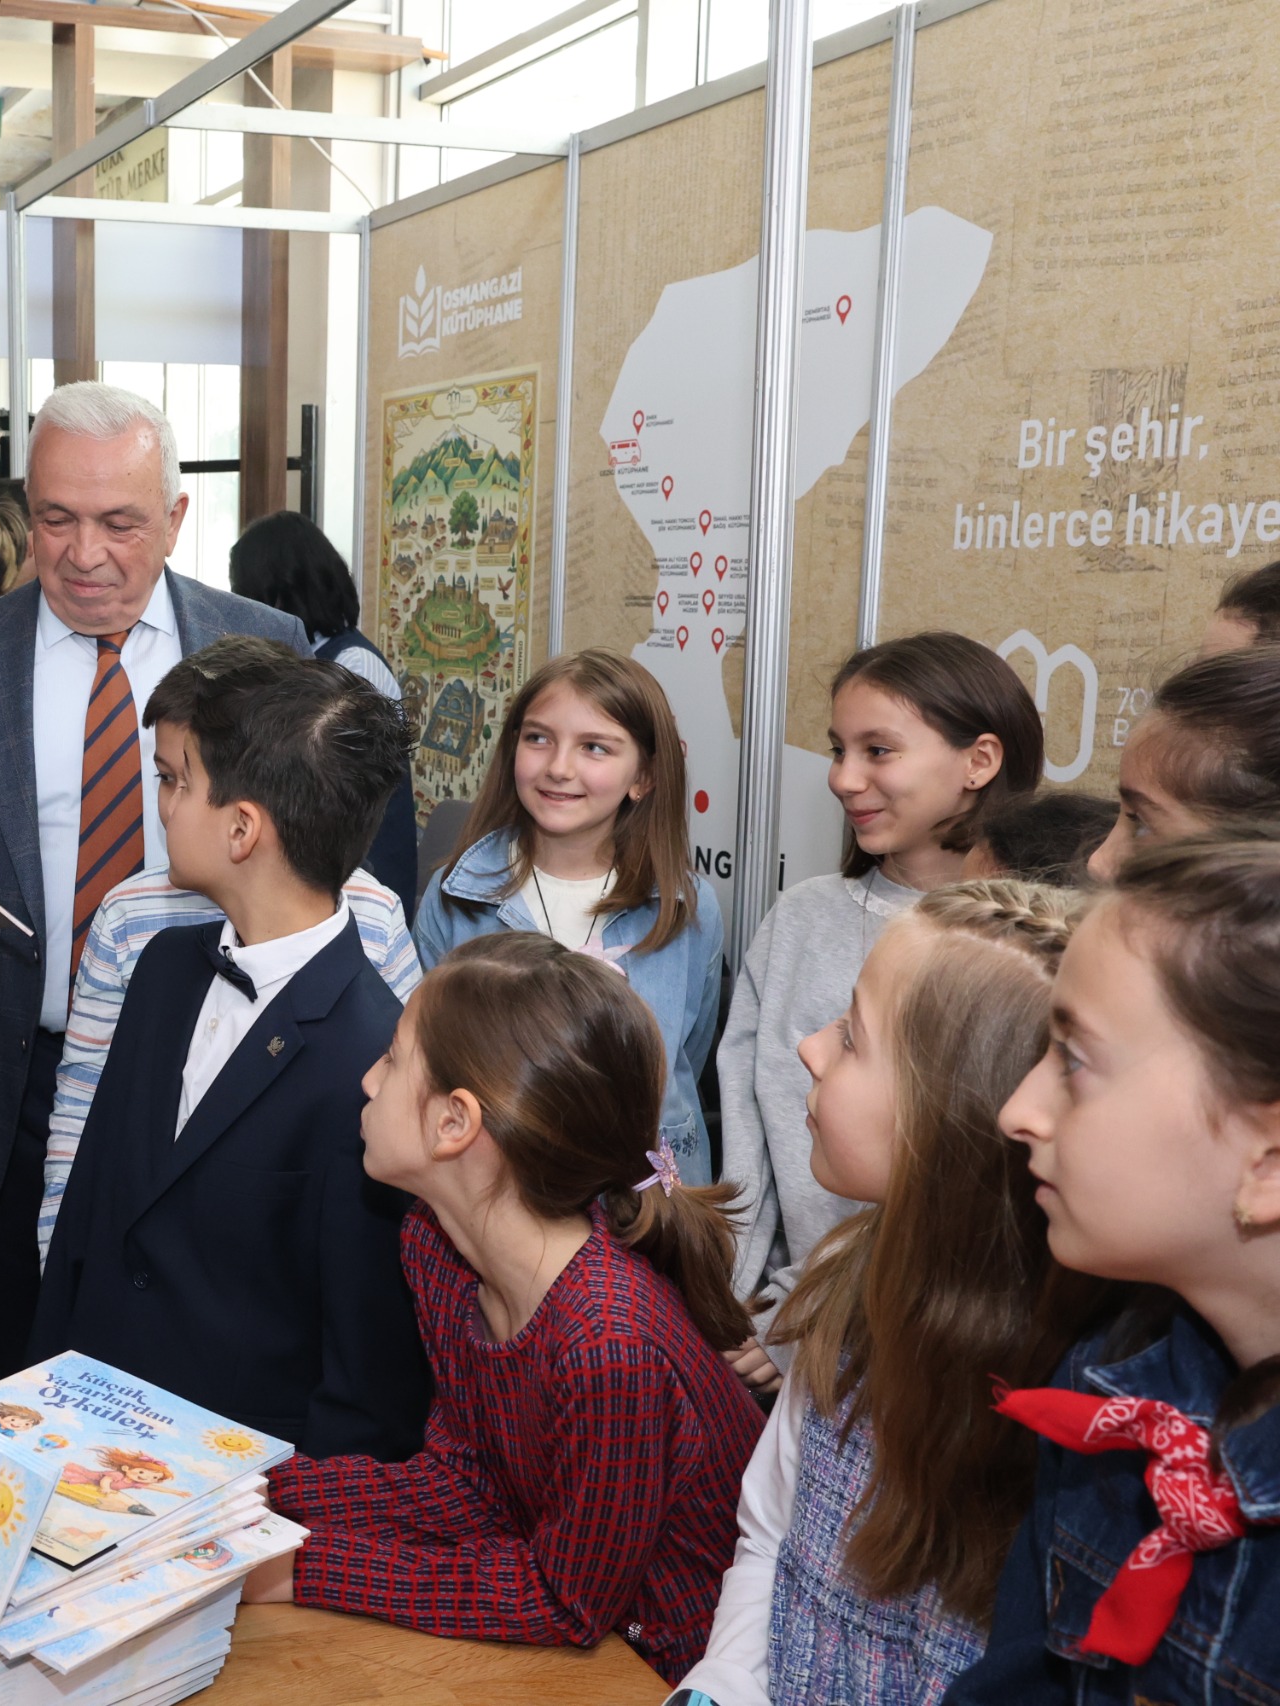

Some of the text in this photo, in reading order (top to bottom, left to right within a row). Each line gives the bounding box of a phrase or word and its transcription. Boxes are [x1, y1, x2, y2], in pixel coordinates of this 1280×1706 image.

[442, 266, 523, 311] OSMANGAZİ
[441, 298, 523, 337] KÜTÜPHANE
[1018, 417, 1076, 470] Bir
[1084, 403, 1209, 478] şehir,
[953, 500, 1113, 550] binlerce
[1125, 490, 1280, 559] hikaye
[38, 1385, 154, 1432] Öyküler
[45, 1372, 174, 1425] Yazarlardan
[78, 1371, 149, 1405] Küçük
